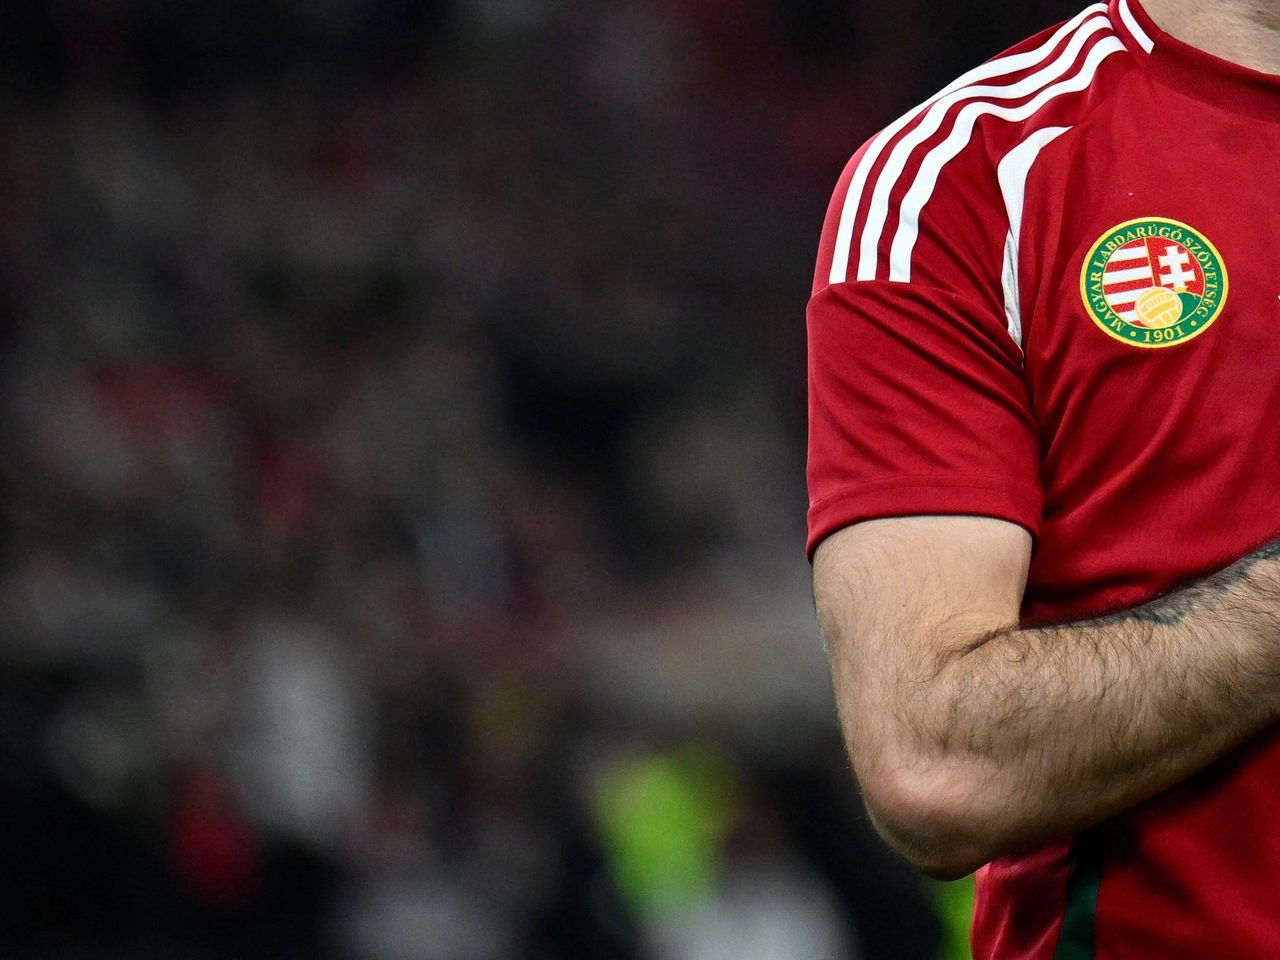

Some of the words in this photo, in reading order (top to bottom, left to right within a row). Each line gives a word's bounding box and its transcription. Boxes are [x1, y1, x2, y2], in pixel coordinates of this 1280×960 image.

[1093, 224, 1183, 269] LABDARÚGÓ
[1090, 271, 1126, 333] MAGYAR
[1143, 325, 1185, 343] 1901
